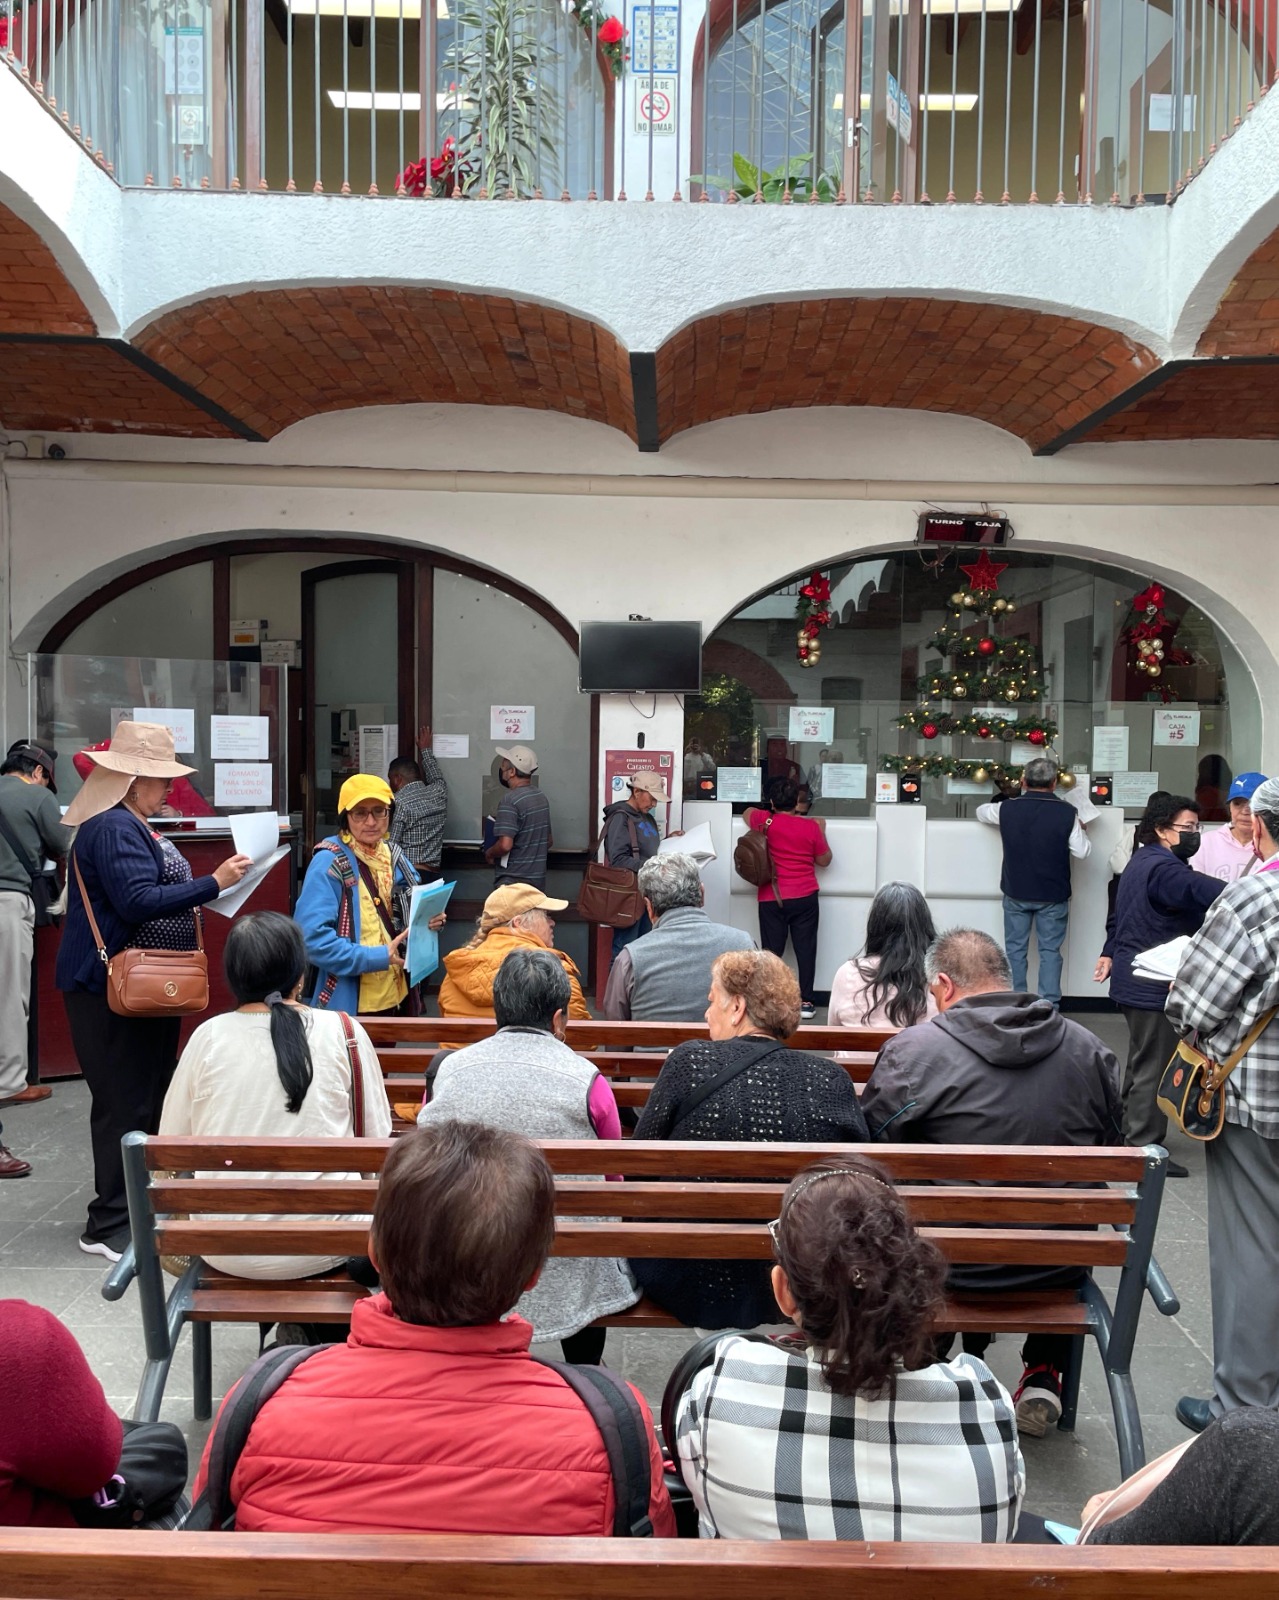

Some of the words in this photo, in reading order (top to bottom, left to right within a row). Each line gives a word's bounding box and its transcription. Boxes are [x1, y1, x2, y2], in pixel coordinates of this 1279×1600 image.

[640, 80, 658, 89] ÁRA
[660, 81, 669, 89] DE
[637, 123, 647, 131] NO
[650, 123, 672, 131] UMAR
[505, 724, 520, 733] #2
[804, 726, 818, 735] #3
[1169, 730, 1184, 739] #5
